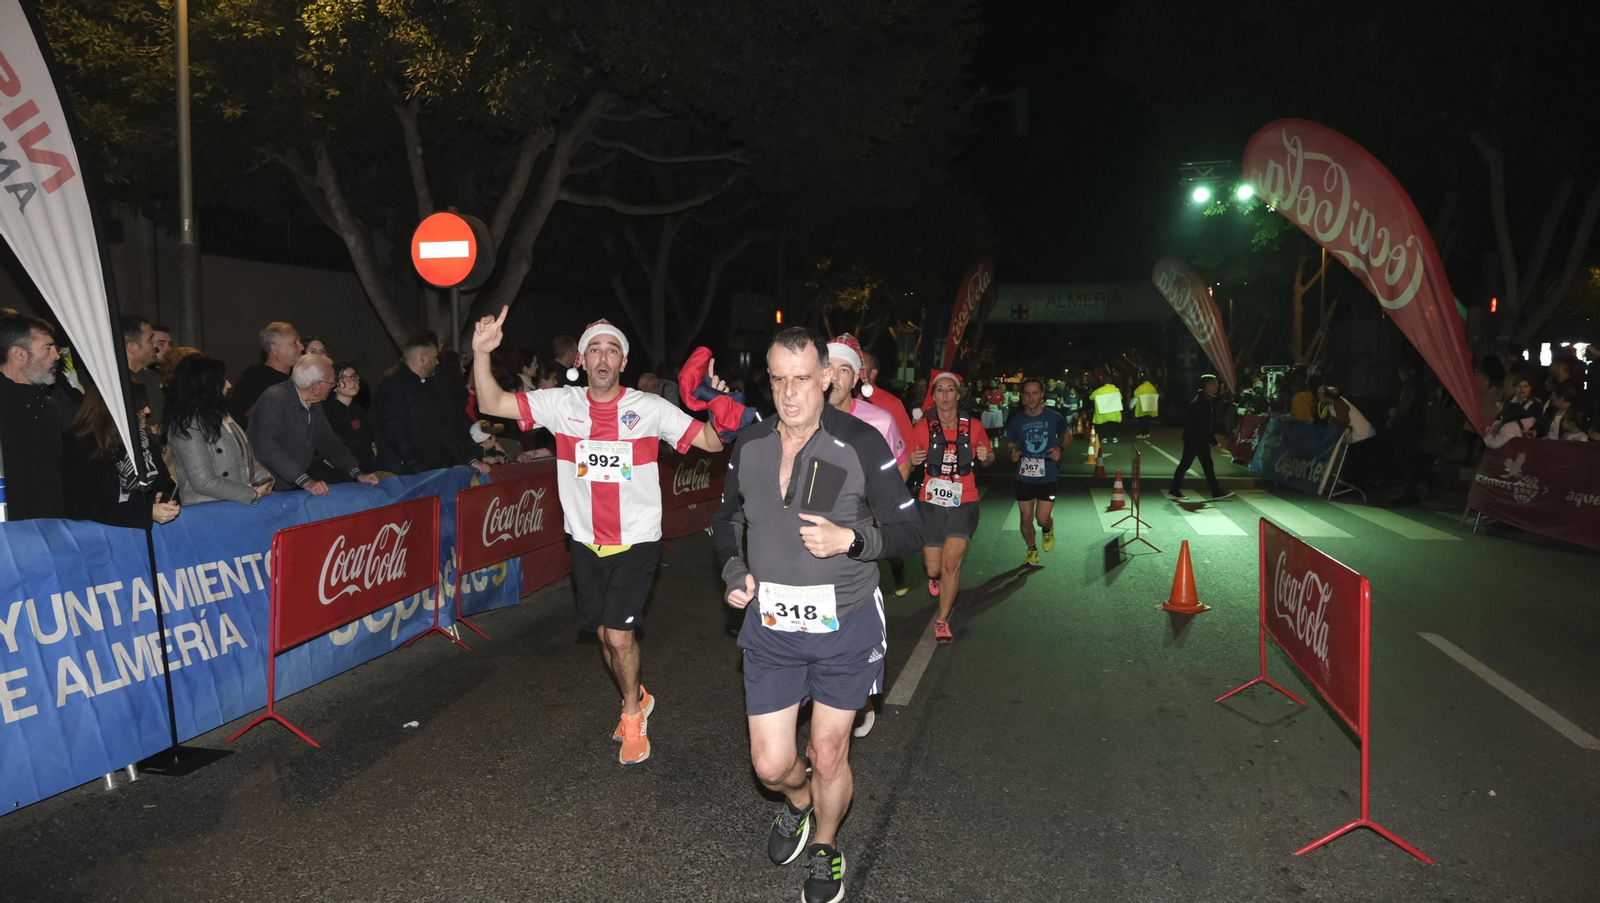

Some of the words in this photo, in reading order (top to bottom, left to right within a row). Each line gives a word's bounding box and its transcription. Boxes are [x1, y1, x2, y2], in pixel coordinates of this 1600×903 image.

[588, 453, 620, 467] 992
[672, 458, 712, 496] Coca-Cola
[1024, 463, 1039, 471] 367
[933, 487, 953, 498] 108
[482, 487, 547, 548] Coca-Cola
[318, 520, 412, 606] Coca-Cola
[775, 602, 817, 620] 318
[1274, 550, 1334, 662] Coca-Cola
[57, 608, 248, 707] ALMERÍA
